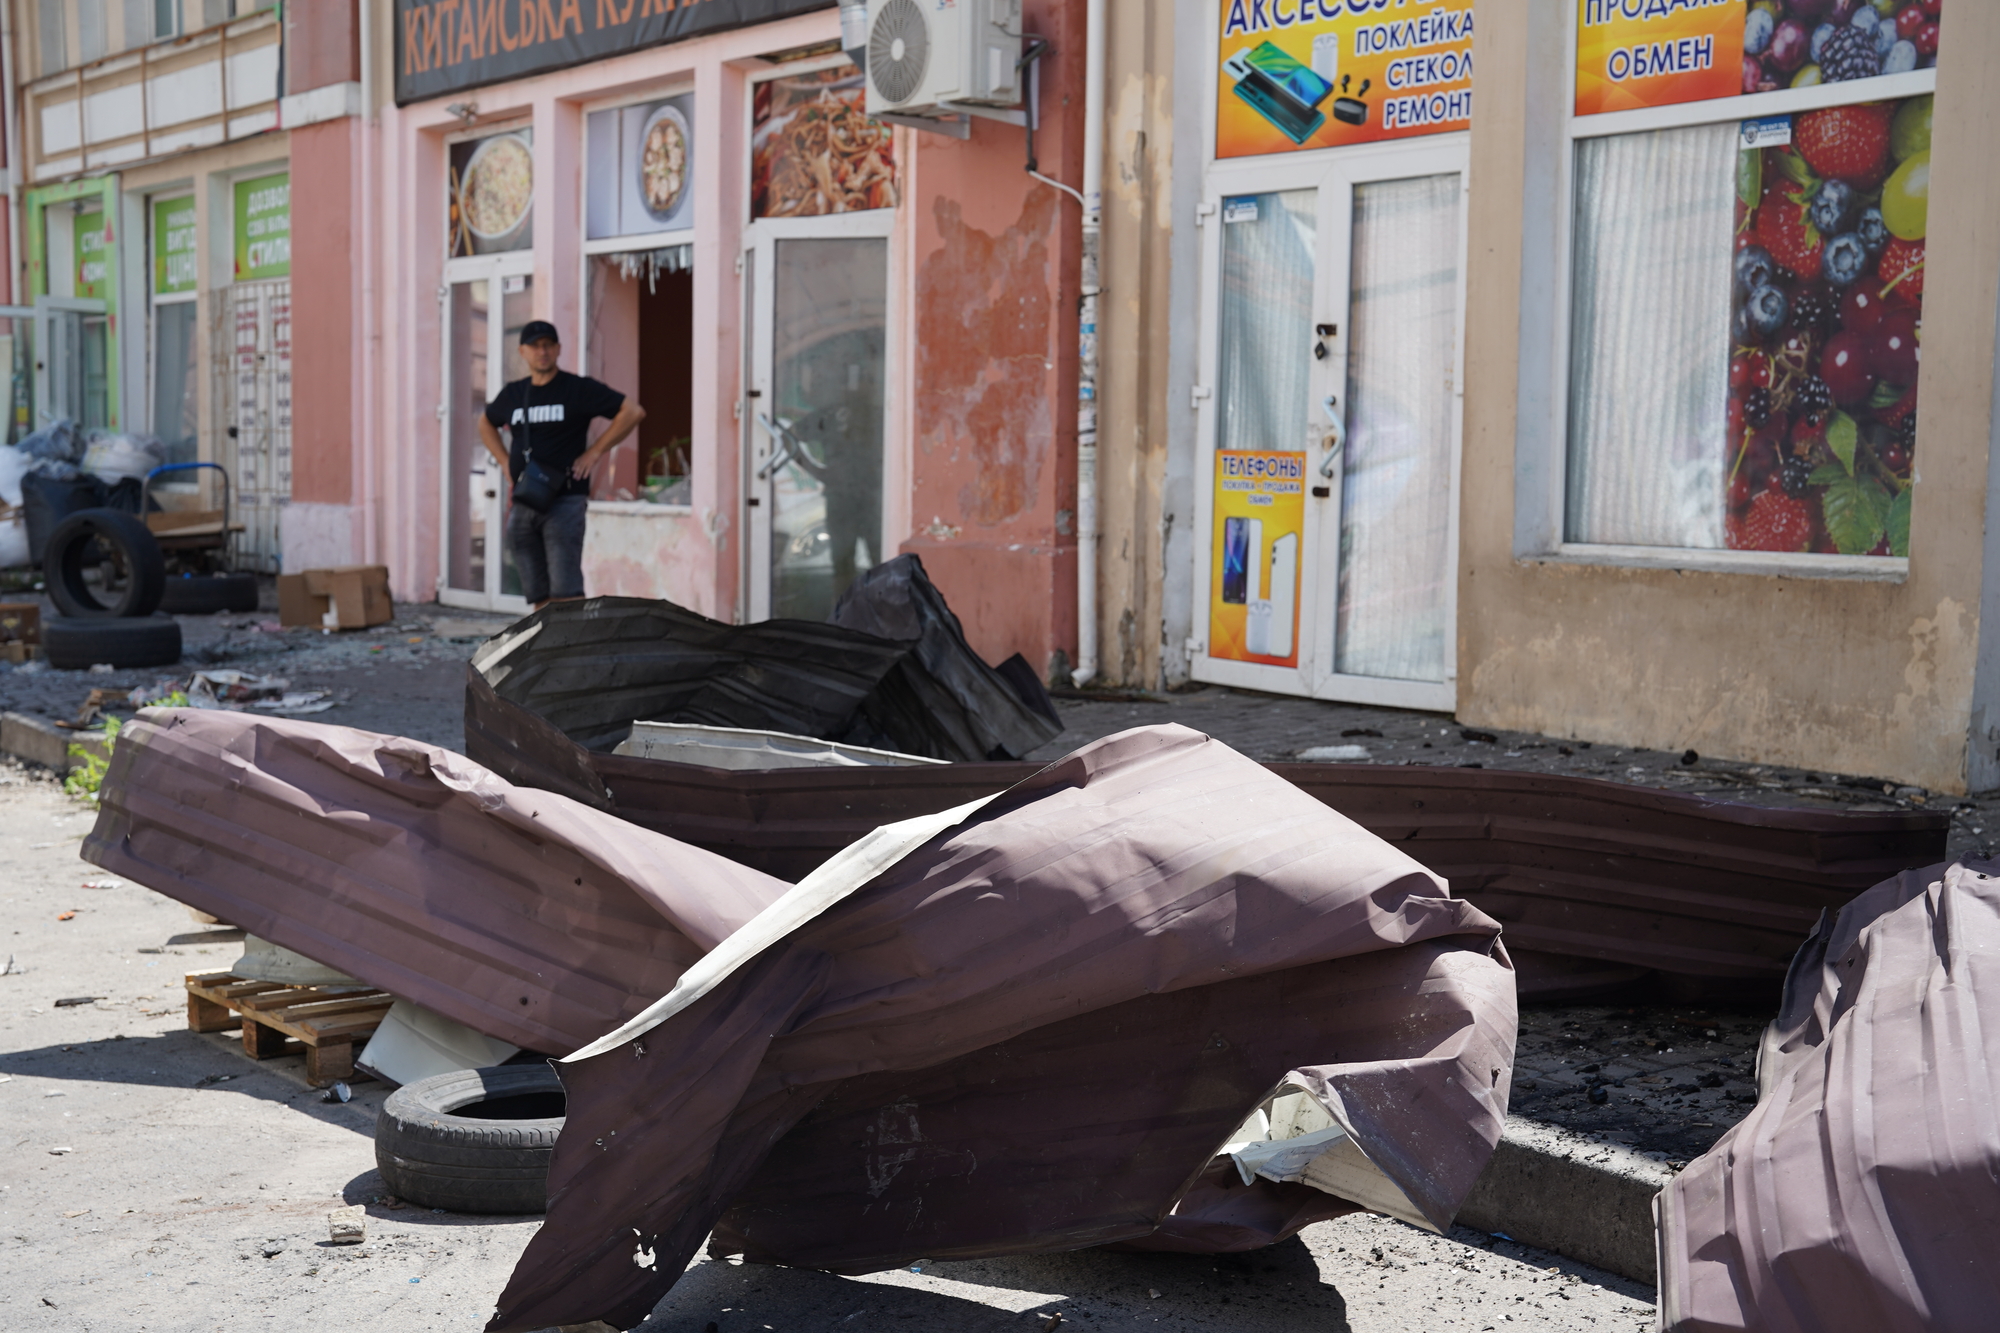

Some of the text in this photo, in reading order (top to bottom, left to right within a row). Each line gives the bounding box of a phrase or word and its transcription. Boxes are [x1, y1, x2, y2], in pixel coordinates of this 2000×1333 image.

[1356, 11, 1473, 54] ПОКЛЕЙКА
[1387, 53, 1473, 87] СТЕКОЛ
[1608, 37, 1713, 79] ОБМЕН
[1385, 92, 1471, 126] РЕМОНТ
[1222, 457, 1303, 477] ТЕЛЕФОНЫ
